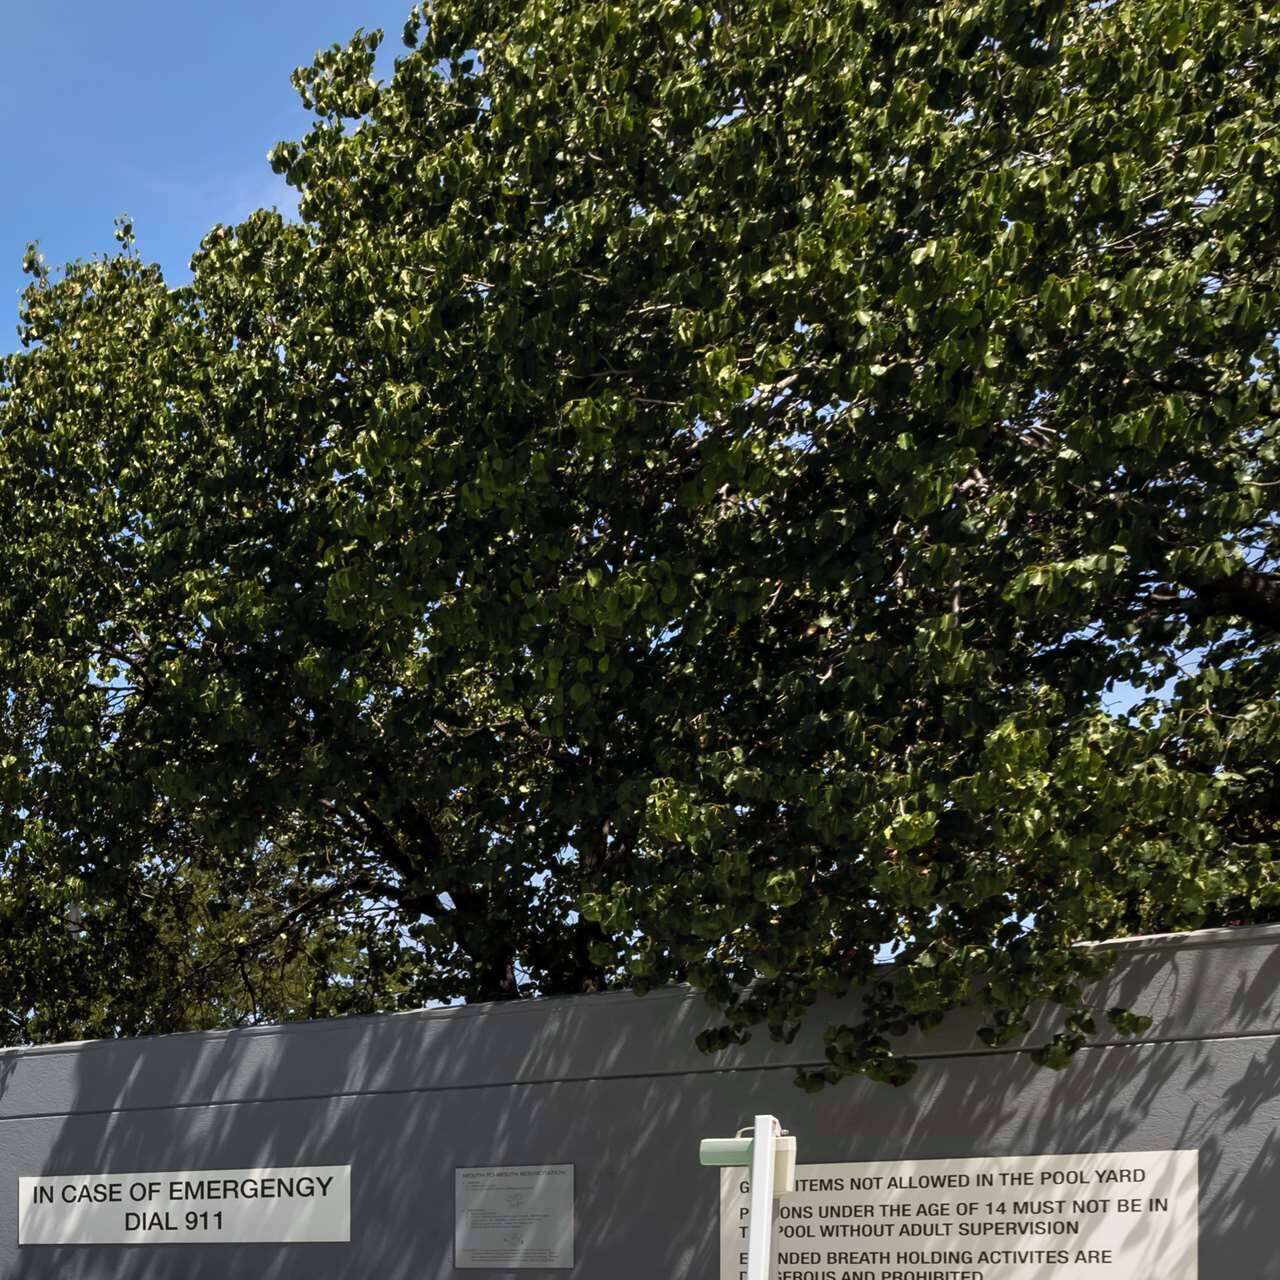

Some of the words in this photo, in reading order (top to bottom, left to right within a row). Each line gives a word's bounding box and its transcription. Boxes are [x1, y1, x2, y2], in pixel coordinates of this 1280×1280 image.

[795, 1178, 844, 1192] ITEMS
[850, 1177, 883, 1190] NOT
[887, 1174, 970, 1189] ALLOWED
[976, 1174, 994, 1187] IN
[999, 1172, 1034, 1186] THE
[1040, 1170, 1090, 1185] POOL
[1095, 1169, 1146, 1184] YARD
[33, 1186, 54, 1204] IN
[61, 1184, 122, 1203] CASE
[129, 1182, 162, 1201] OF
[818, 1205, 875, 1219] UNDER
[879, 1204, 911, 1217] THE
[916, 1203, 950, 1216] AGE
[956, 1202, 979, 1216] OF
[985, 1201, 1007, 1215] 14
[1012, 1200, 1066, 1215] MUST
[1072, 1199, 1111, 1213] NOT
[1117, 1199, 1142, 1213] BE
[1148, 1198, 1168, 1212] IN
[125, 1212, 178, 1231] DIAL
[185, 1211, 224, 1230] 911
[819, 1224, 895, 1238] WITHOUT
[899, 1223, 952, 1237] ADULT
[958, 1221, 1079, 1236] SUPERVISION
[826, 1252, 890, 1265] BREATH
[896, 1251, 972, 1265] HOLDING
[977, 1250, 1069, 1264] ACTIVITES
[1074, 1250, 1113, 1264] ARE
